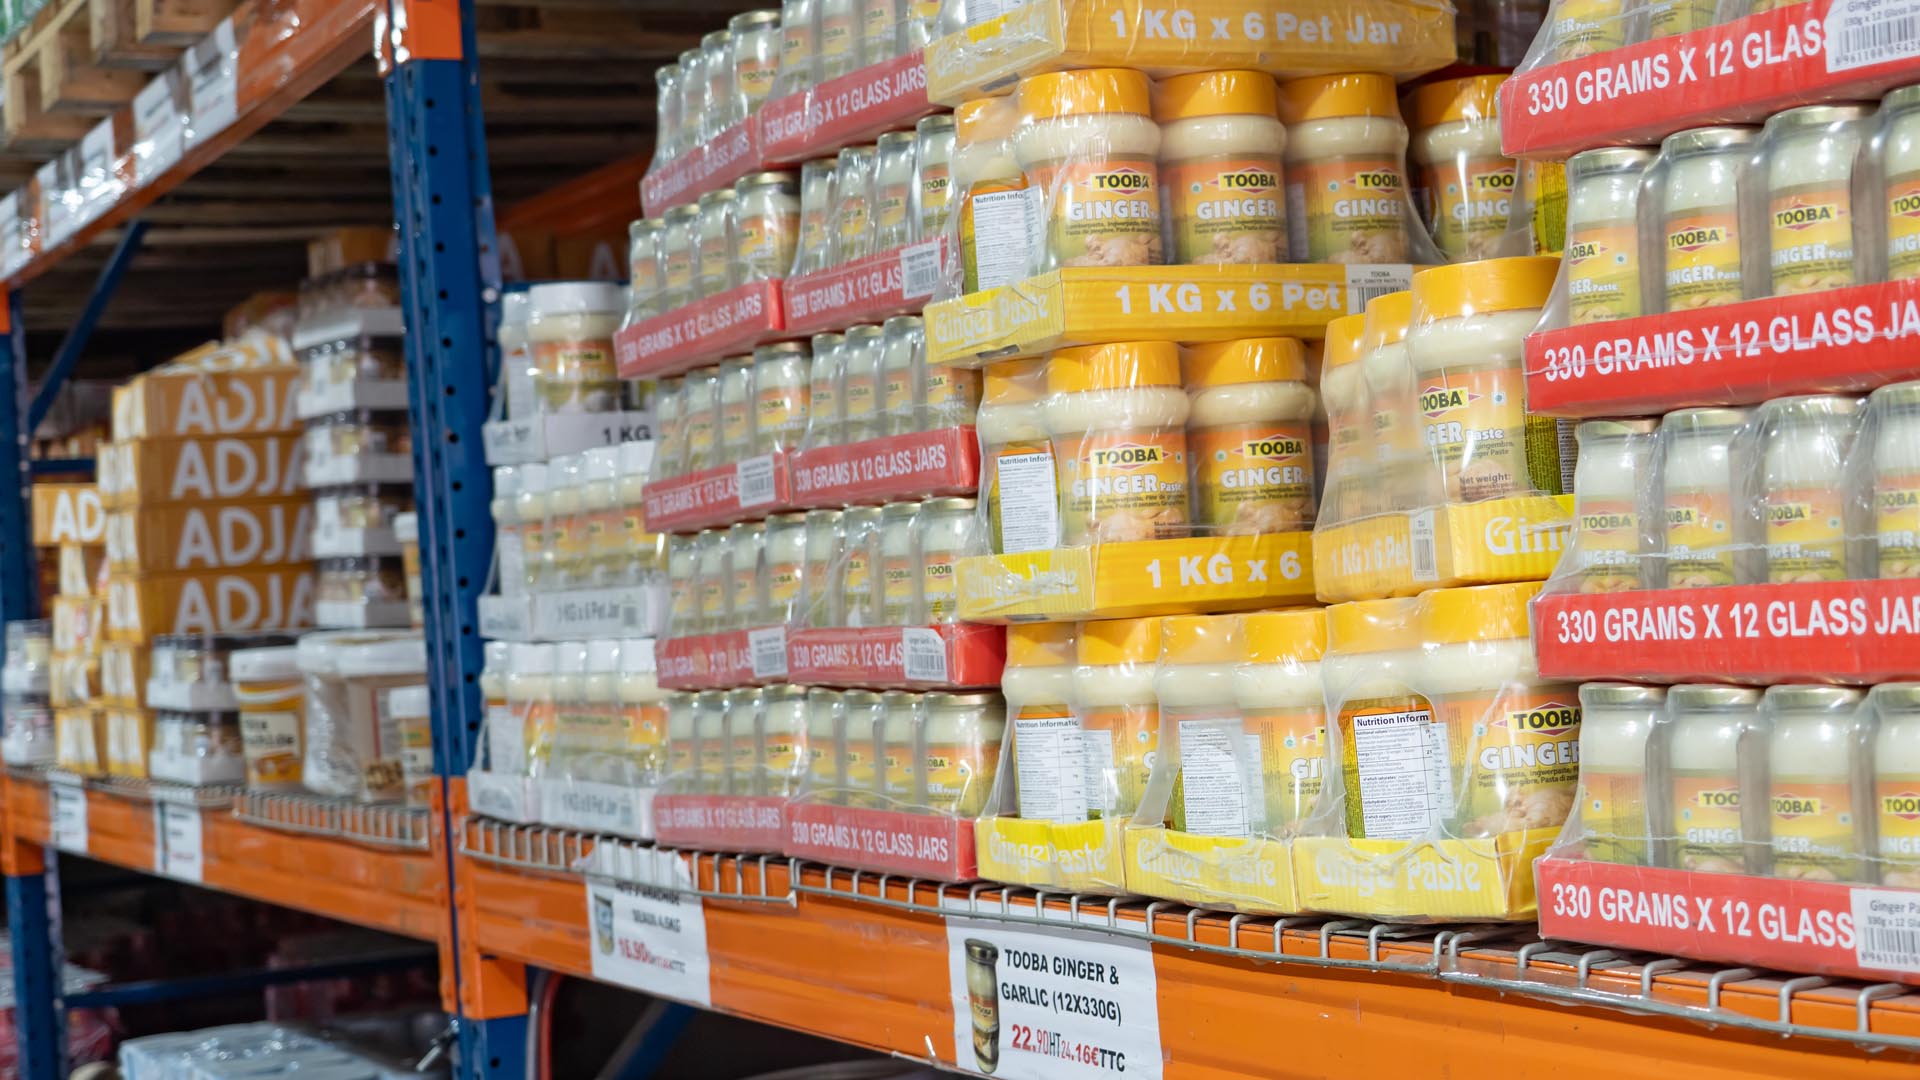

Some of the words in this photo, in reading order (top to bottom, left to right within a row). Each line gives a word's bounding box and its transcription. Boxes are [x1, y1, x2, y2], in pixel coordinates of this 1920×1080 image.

[1110, 8, 1126, 38] 1
[1144, 9, 1197, 39] KG
[1211, 18, 1230, 40] x
[1243, 12, 1265, 40] 6
[1276, 12, 1333, 42] Pet
[1346, 15, 1402, 44] Jar
[1528, 76, 1568, 116] 330
[1575, 47, 1670, 105] GRAMS
[1678, 48, 1697, 84] X
[1705, 39, 1734, 77] 12
[824, 99, 834, 121] X
[835, 91, 849, 117] 12
[850, 76, 891, 112] GLASS
[894, 64, 927, 97] JARS
[1096, 174, 1149, 188] TOOBA
[1224, 174, 1277, 188] TOOBA
[1071, 199, 1150, 221] GINGER
[1197, 199, 1278, 219] GINGER
[1776, 206, 1831, 226] TOOBA
[1670, 230, 1719, 248] TOOBA
[810, 283, 846, 313] GRAMS
[857, 275, 868, 298] 12
[1115, 286, 1131, 313] 1
[1149, 283, 1202, 313] KG
[1216, 291, 1236, 311] x
[1249, 283, 1271, 312] 6
[1282, 283, 1341, 311] Pet
[733, 294, 763, 323] JARS
[1544, 346, 1586, 382] 330
[1594, 329, 1695, 376] GRAMS
[1702, 326, 1722, 362] X
[1730, 321, 1760, 357] 12
[1768, 305, 1875, 353] GLASS
[603, 427, 611, 443] 1
[620, 425, 652, 441] KG
[1095, 448, 1158, 464] TOOBA
[1248, 441, 1302, 455] TOOBA
[813, 461, 849, 489] GRAMS
[851, 460, 860, 483] X
[861, 458, 873, 480] 12
[875, 450, 912, 478] GLASS
[915, 444, 947, 471] JARS
[1221, 466, 1302, 488] GINGER
[1071, 474, 1157, 497] GINGER
[1583, 516, 1632, 528] TOOBA
[1146, 559, 1161, 588] 1
[1180, 554, 1233, 586] KG
[1248, 559, 1267, 580] x
[1280, 551, 1301, 580] 6
[1342, 542, 1361, 576] KG
[1557, 609, 1597, 644] 330
[1604, 604, 1696, 642] GRAMS
[1703, 605, 1722, 638] X
[1729, 603, 1759, 638] 12
[1767, 599, 1867, 637] GLASS
[811, 644, 849, 667] GRAMS
[861, 643, 872, 665] 12
[1357, 715, 1395, 727] Nutrition
[1397, 714, 1428, 722] Inform
[1513, 709, 1581, 729] TOOBA
[811, 822, 850, 848] GRAMS
[850, 827, 860, 849] X
[861, 829, 873, 851] 12
[875, 830, 913, 857] GLASS
[917, 836, 948, 862] JARS
[1552, 883, 1591, 919] 330
[1598, 885, 1689, 930] GRAMS
[1695, 897, 1715, 933] X
[1722, 900, 1752, 937] 12
[1758, 904, 1856, 949] GLASS
[1870, 900, 1905, 915] Ginger
[1004, 949, 1049, 973] TOOBA
[1053, 956, 1104, 983] GINGER
[1110, 965, 1119, 985] &
[1001, 982, 1049, 1008] GARLIC
[1053, 991, 1122, 1027] (12X330G)
